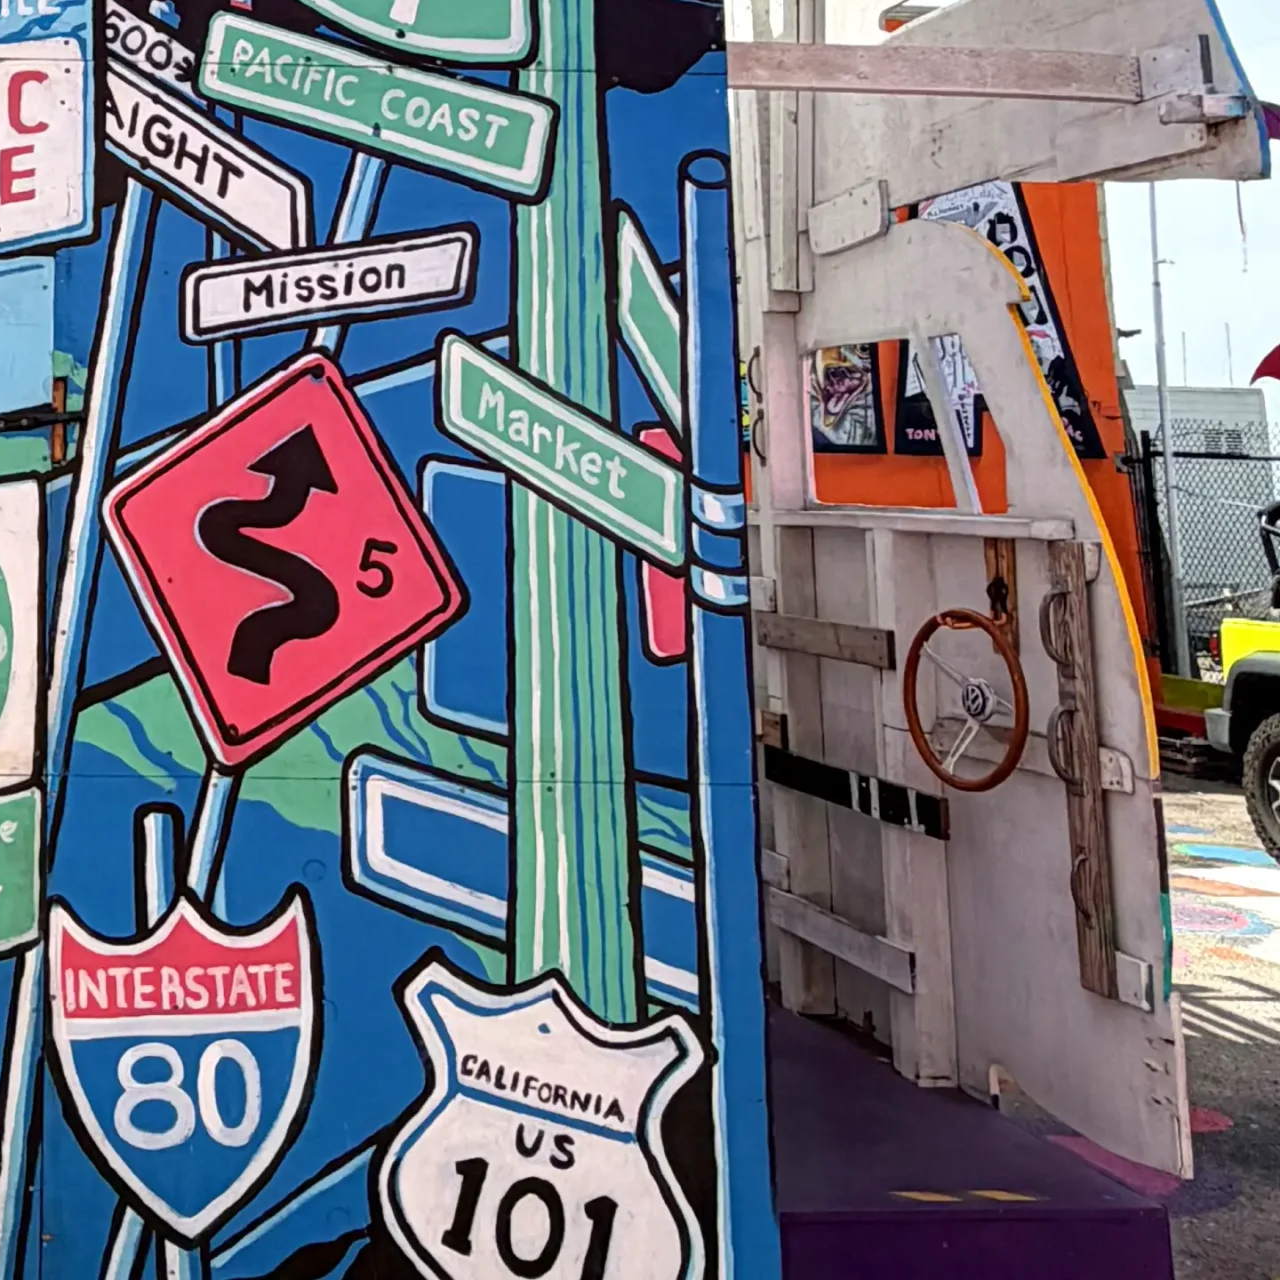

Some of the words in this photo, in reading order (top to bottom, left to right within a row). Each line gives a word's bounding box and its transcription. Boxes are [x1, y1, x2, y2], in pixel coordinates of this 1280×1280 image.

[232, 38, 359, 107] PACIFIC
[381, 89, 510, 149] COAST
[243, 263, 405, 313] Mission
[479, 382, 628, 500] Market
[356, 539, 398, 598] 5
[65, 961, 296, 1013] INTERSTATE
[114, 1038, 261, 1150] 80
[460, 1054, 625, 1123] CALIFORNIA
[515, 1122, 576, 1170] US
[441, 1157, 619, 1280] 101
